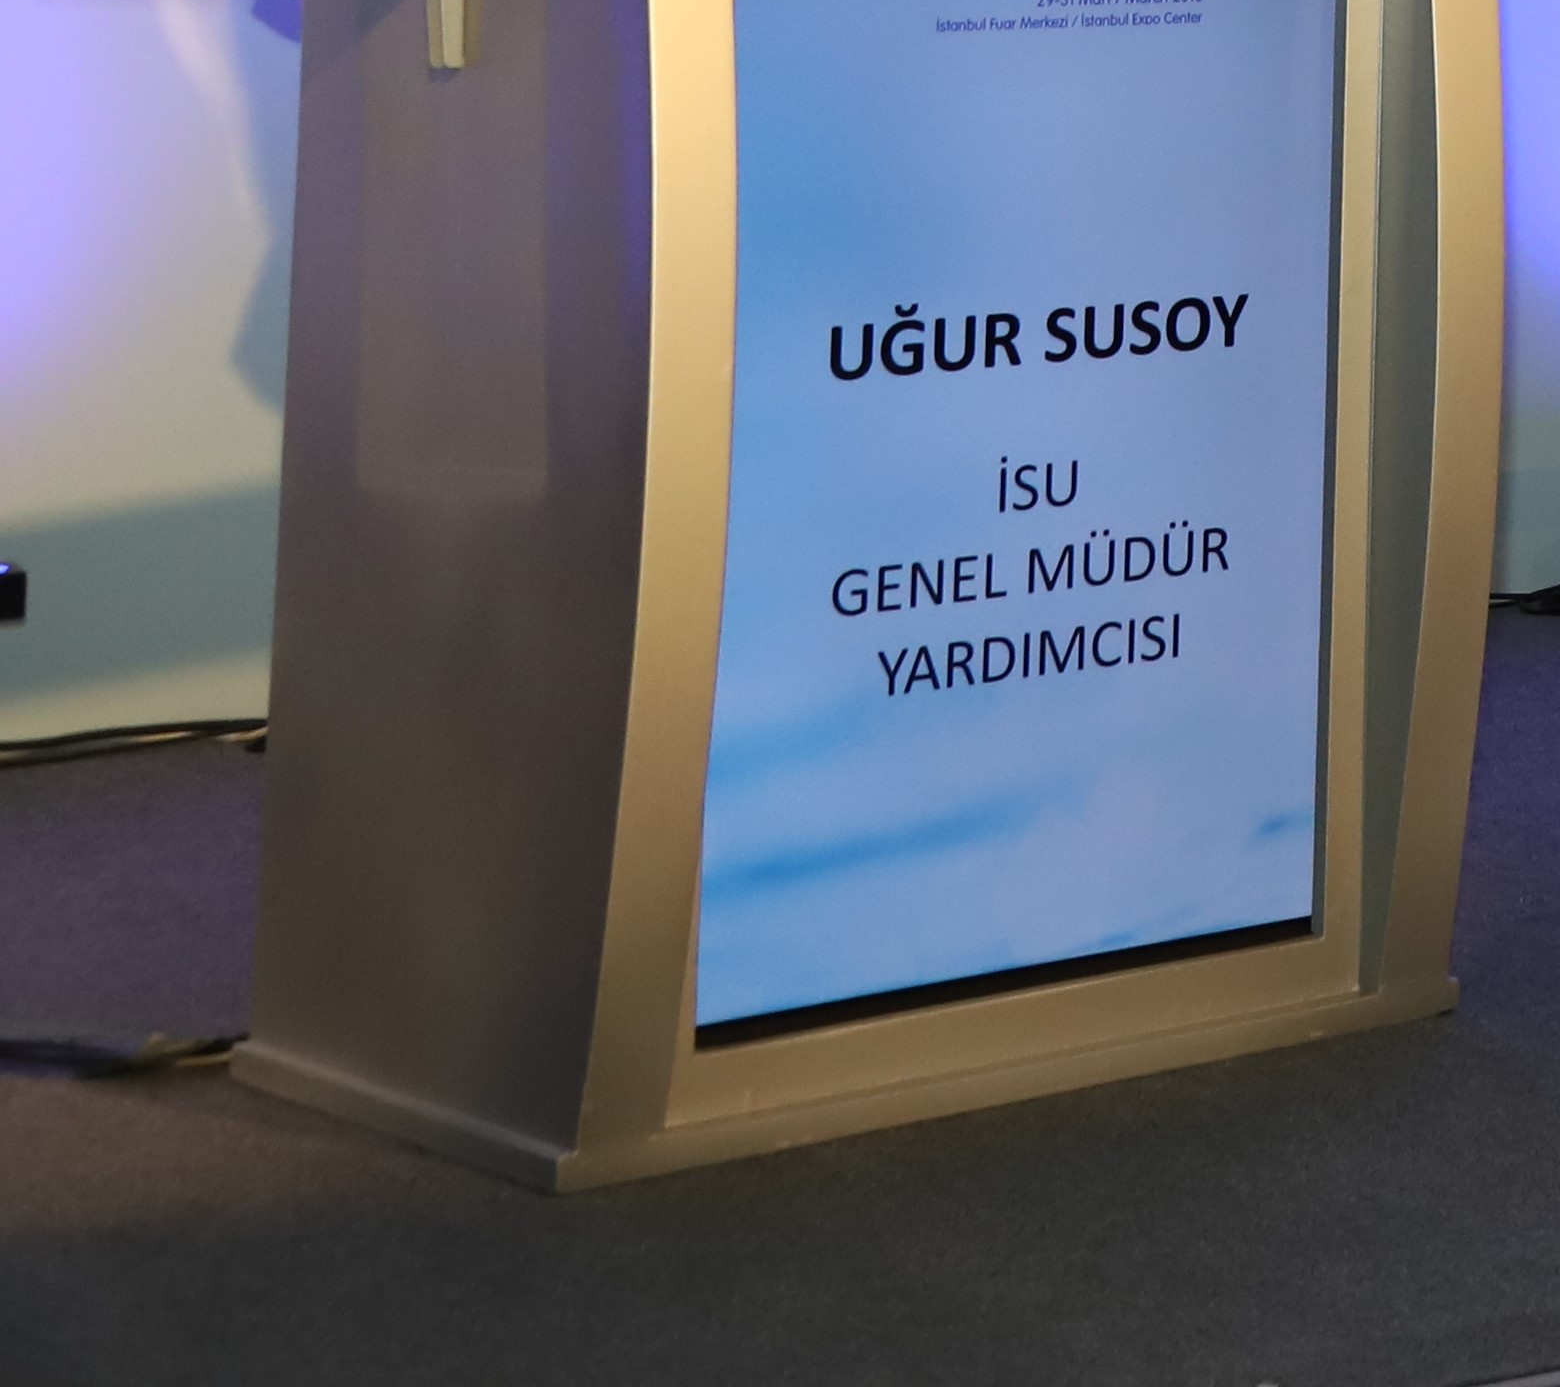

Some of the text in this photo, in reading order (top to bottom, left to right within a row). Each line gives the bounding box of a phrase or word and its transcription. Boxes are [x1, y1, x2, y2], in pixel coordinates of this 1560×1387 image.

[936, 12, 1202, 32] İstanbul Fuar Merkezi İstanbul Expo Center
[828, 293, 1249, 381] UĞUR SUSOY
[997, 456, 1080, 514] İSU
[831, 519, 1230, 619] GENEL MÜDÜR
[876, 613, 1182, 697] YARDIMCISI
